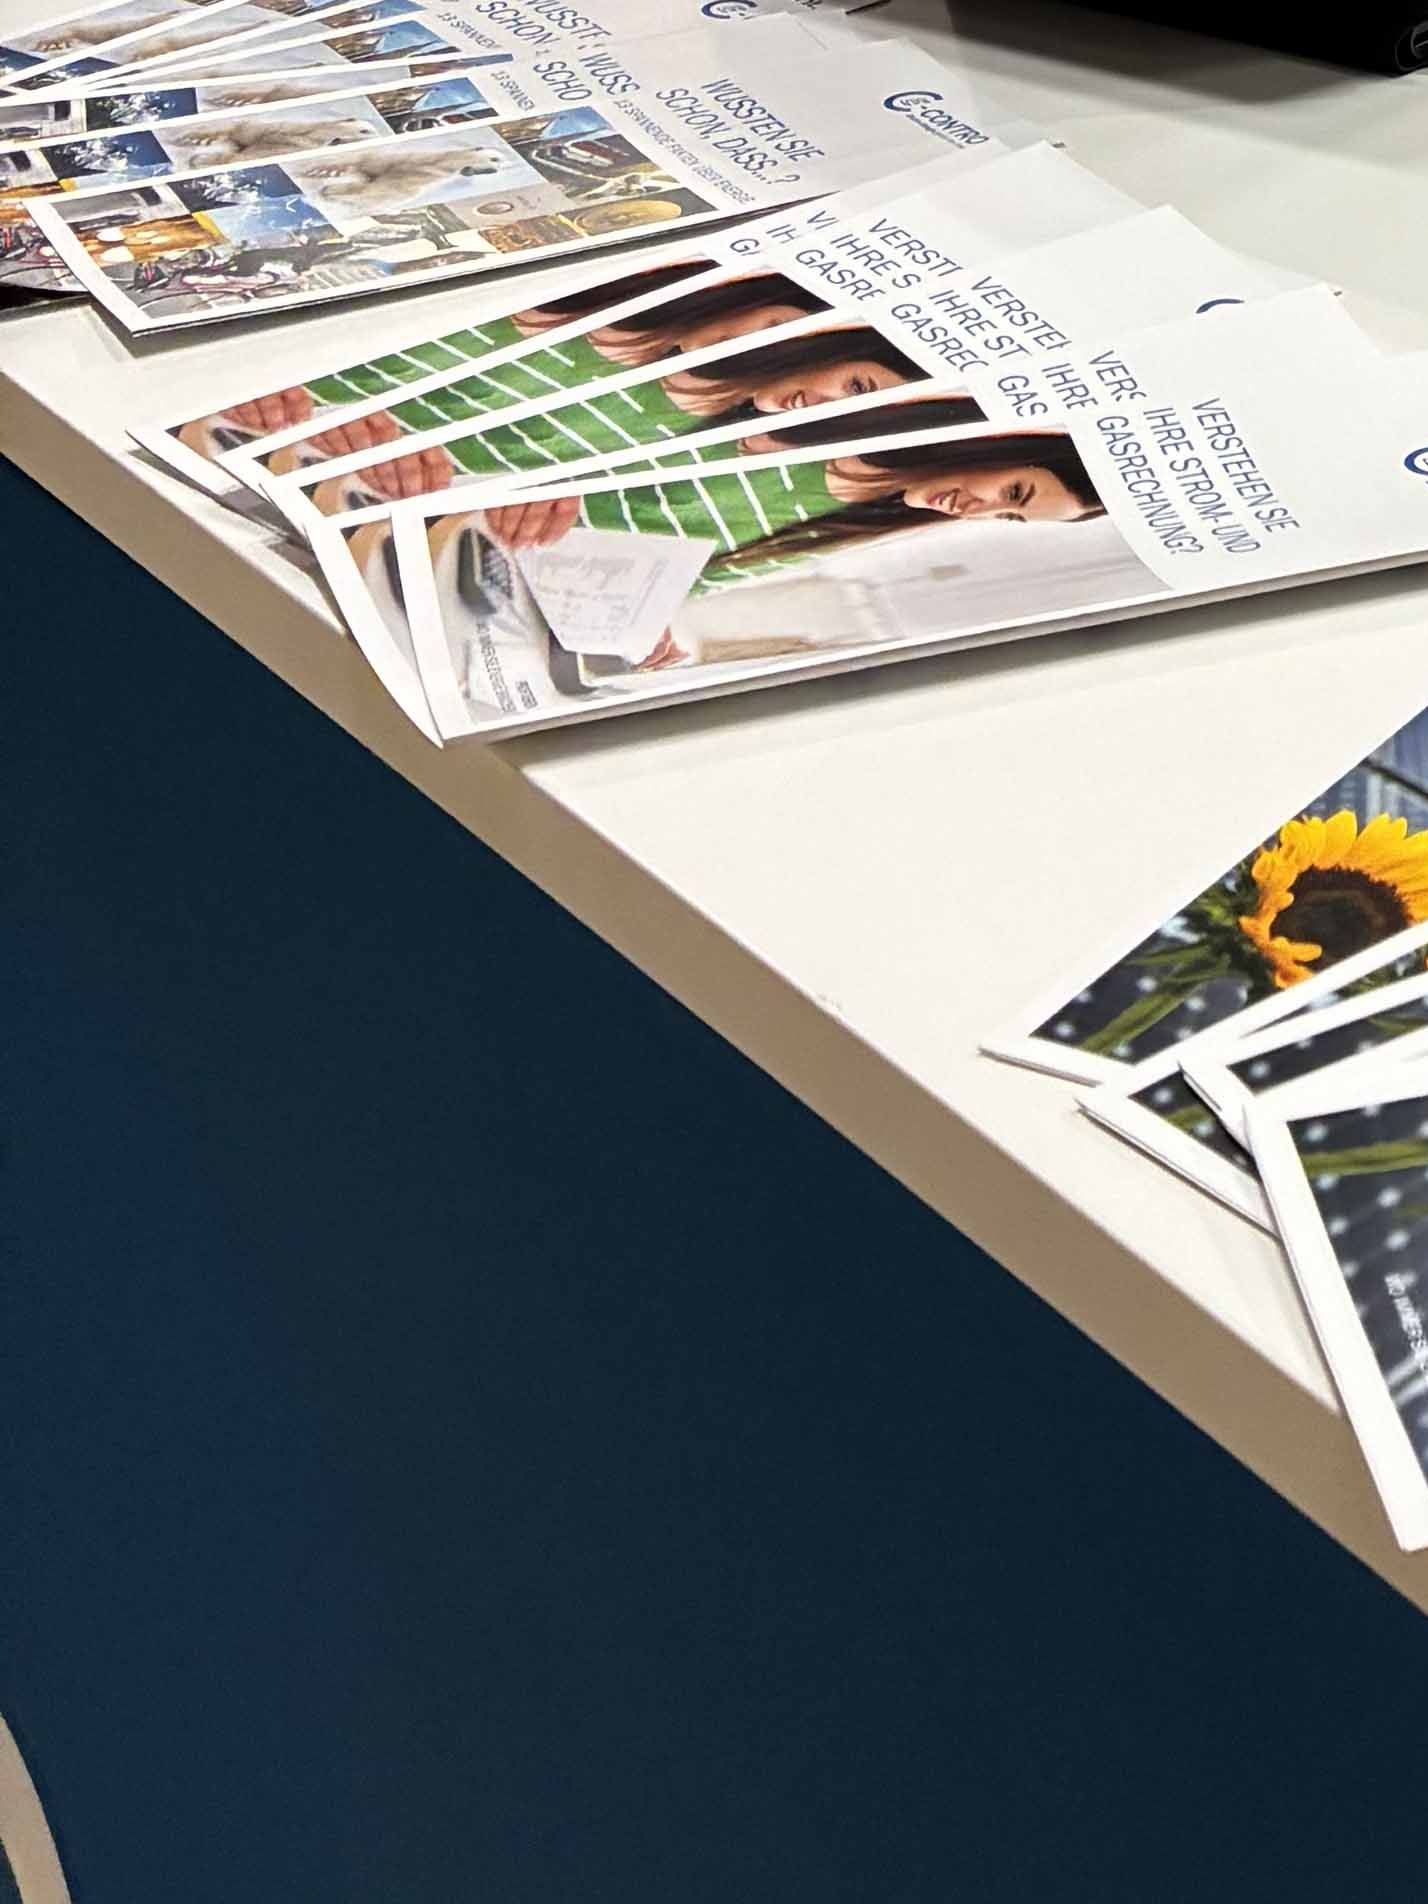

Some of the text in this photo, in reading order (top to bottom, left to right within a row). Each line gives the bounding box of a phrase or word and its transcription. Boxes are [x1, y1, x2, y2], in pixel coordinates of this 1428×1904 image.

[700, 77, 825, 163] WUSSTEN SIE
[830, 233, 902, 277] IHRE
[929, 289, 998, 337] IHRE
[1096, 415, 1204, 555] GASRECHNUNG?
[1143, 407, 1194, 456] IHRE
[1210, 524, 1262, 554] UND
[1192, 397, 1300, 533] VERSTEHEN SIE
